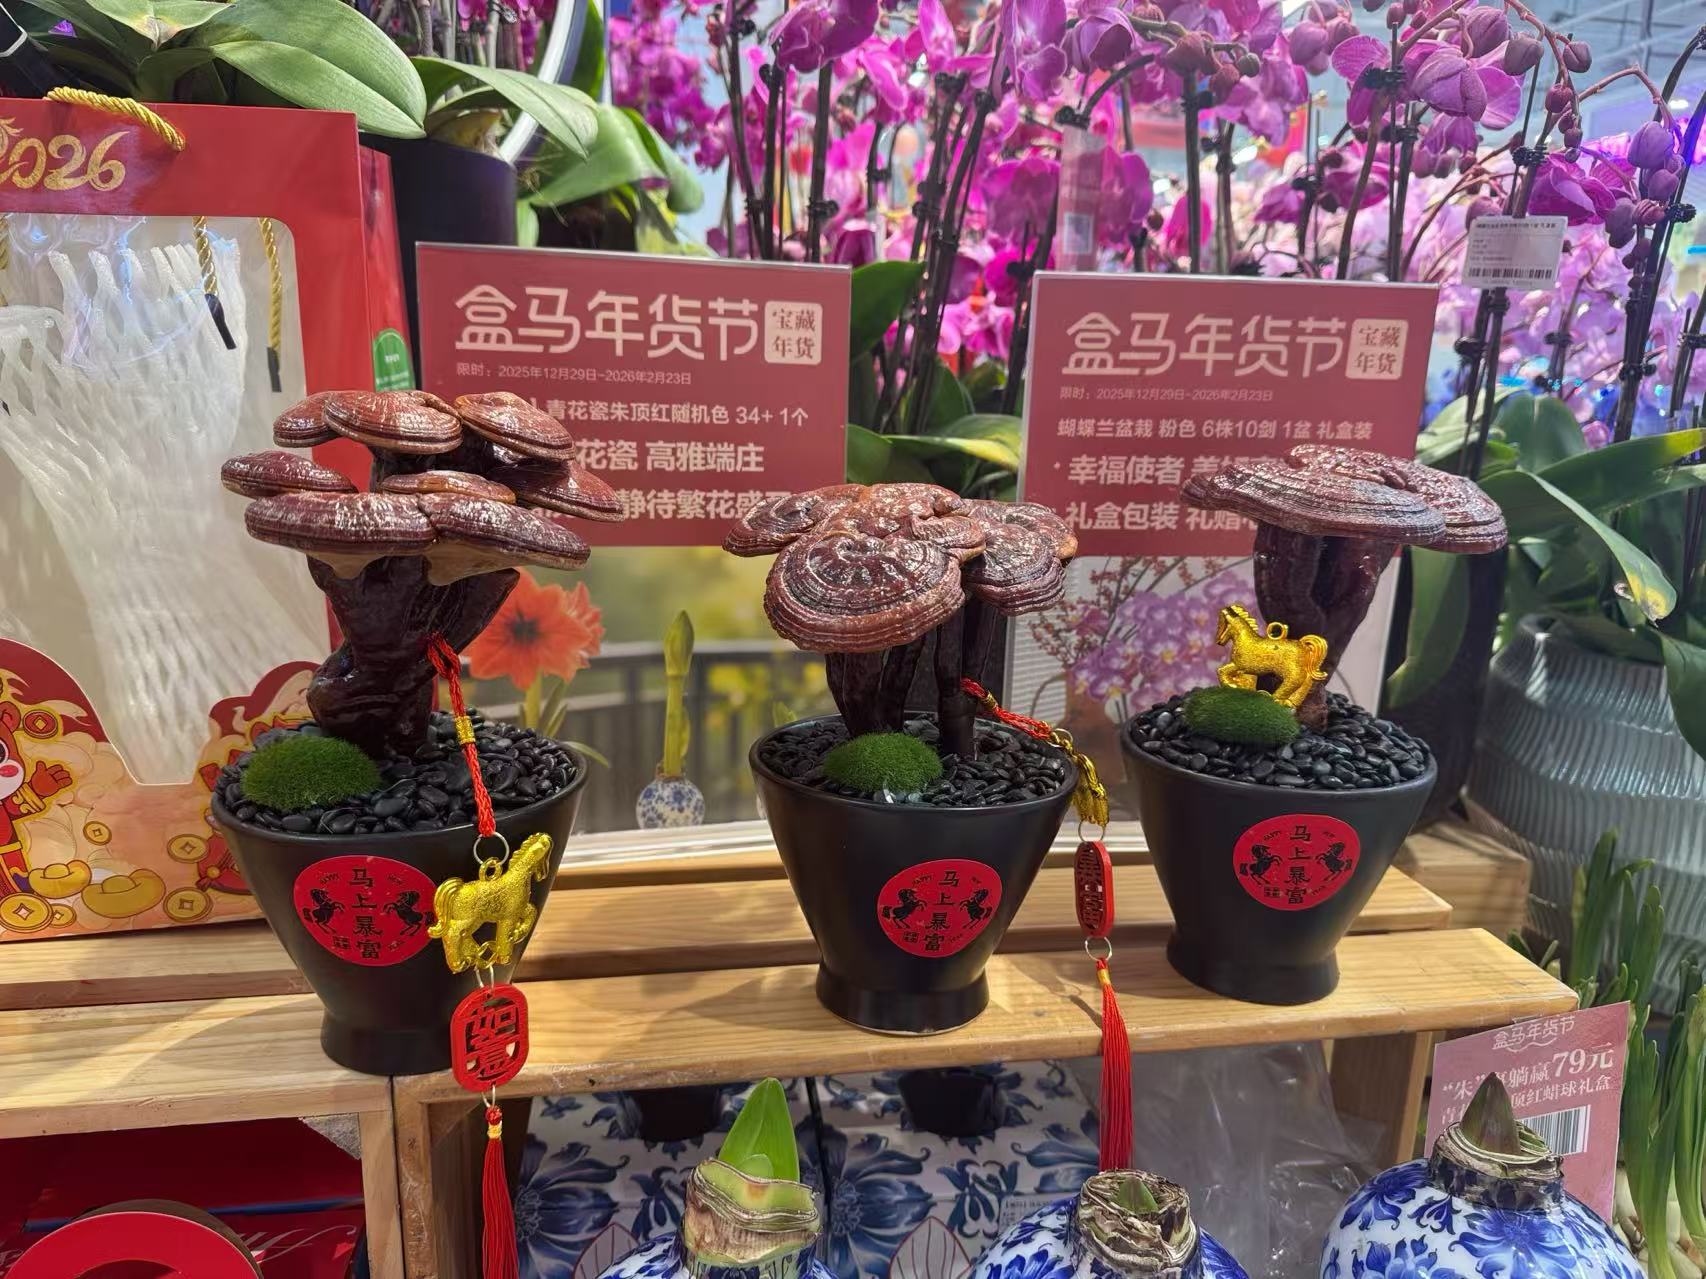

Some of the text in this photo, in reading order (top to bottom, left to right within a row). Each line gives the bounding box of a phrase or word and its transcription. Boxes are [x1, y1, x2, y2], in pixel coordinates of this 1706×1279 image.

[455, 284, 759, 361] 盒马年货节
[772, 307, 817, 332] 宝藏
[772, 336, 817, 361] 年货
[1062, 311, 1347, 378] 盒马年货节
[1358, 325, 1401, 349] 宝藏
[1353, 351, 1398, 375] 年货
[735, 406, 774, 425] 34+
[780, 406, 809, 427] 1个
[1056, 418, 1375, 440] 蝴蝶兰盆栽 粉色 6株10剑 1盆 礼盒装
[645, 440, 765, 473] 高雅端庄
[1067, 453, 1185, 485] 幸福使者
[613, 489, 791, 520] 静待繁花盛
[1064, 502, 1181, 530] 礼盒包装
[1283, 825, 1313, 905] 马上暴富
[349, 867, 384, 960] 马上暴富
[924, 869, 960, 952] 马上暴富
[1491, 1015, 1576, 1050] 盒马年货节
[1551, 1042, 1614, 1078] 79元
